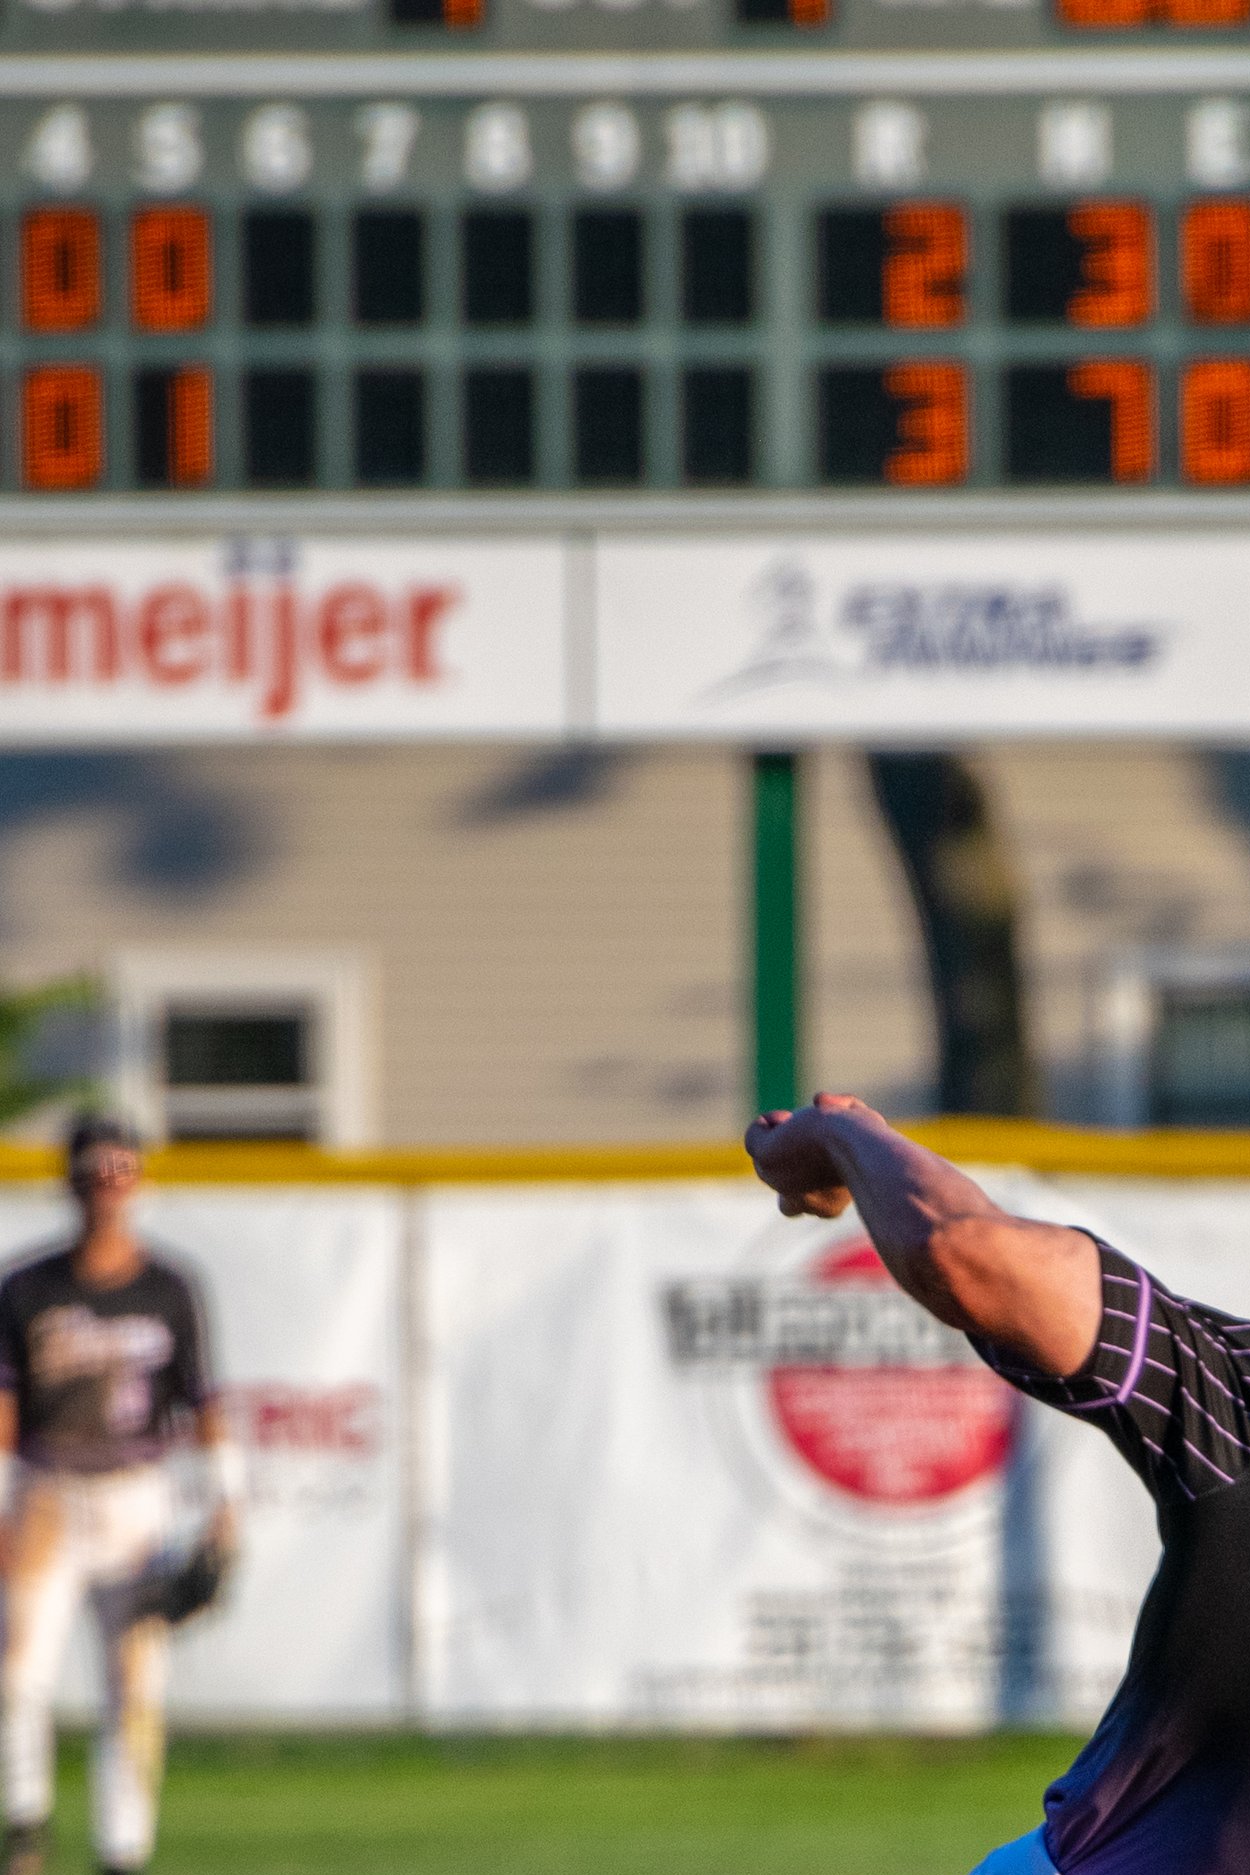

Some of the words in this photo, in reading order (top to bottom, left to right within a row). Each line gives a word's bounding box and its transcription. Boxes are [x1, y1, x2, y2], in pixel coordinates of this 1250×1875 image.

[24, 102, 90, 191] 4
[136, 102, 200, 191] 5
[243, 102, 311, 191] 6
[357, 102, 418, 191] 7
[465, 102, 531, 191] 8
[574, 102, 640, 191] 9
[668, 102, 767, 191] 10
[21, 206, 100, 333] 0
[131, 206, 212, 333] 0
[884, 201, 966, 329] 2
[1068, 201, 1156, 329] 3
[21, 363, 100, 490] 0
[171, 363, 213, 489] 1
[884, 358, 967, 485] 3
[1068, 358, 1156, 484] 7
[0, 533, 462, 721] meijer
